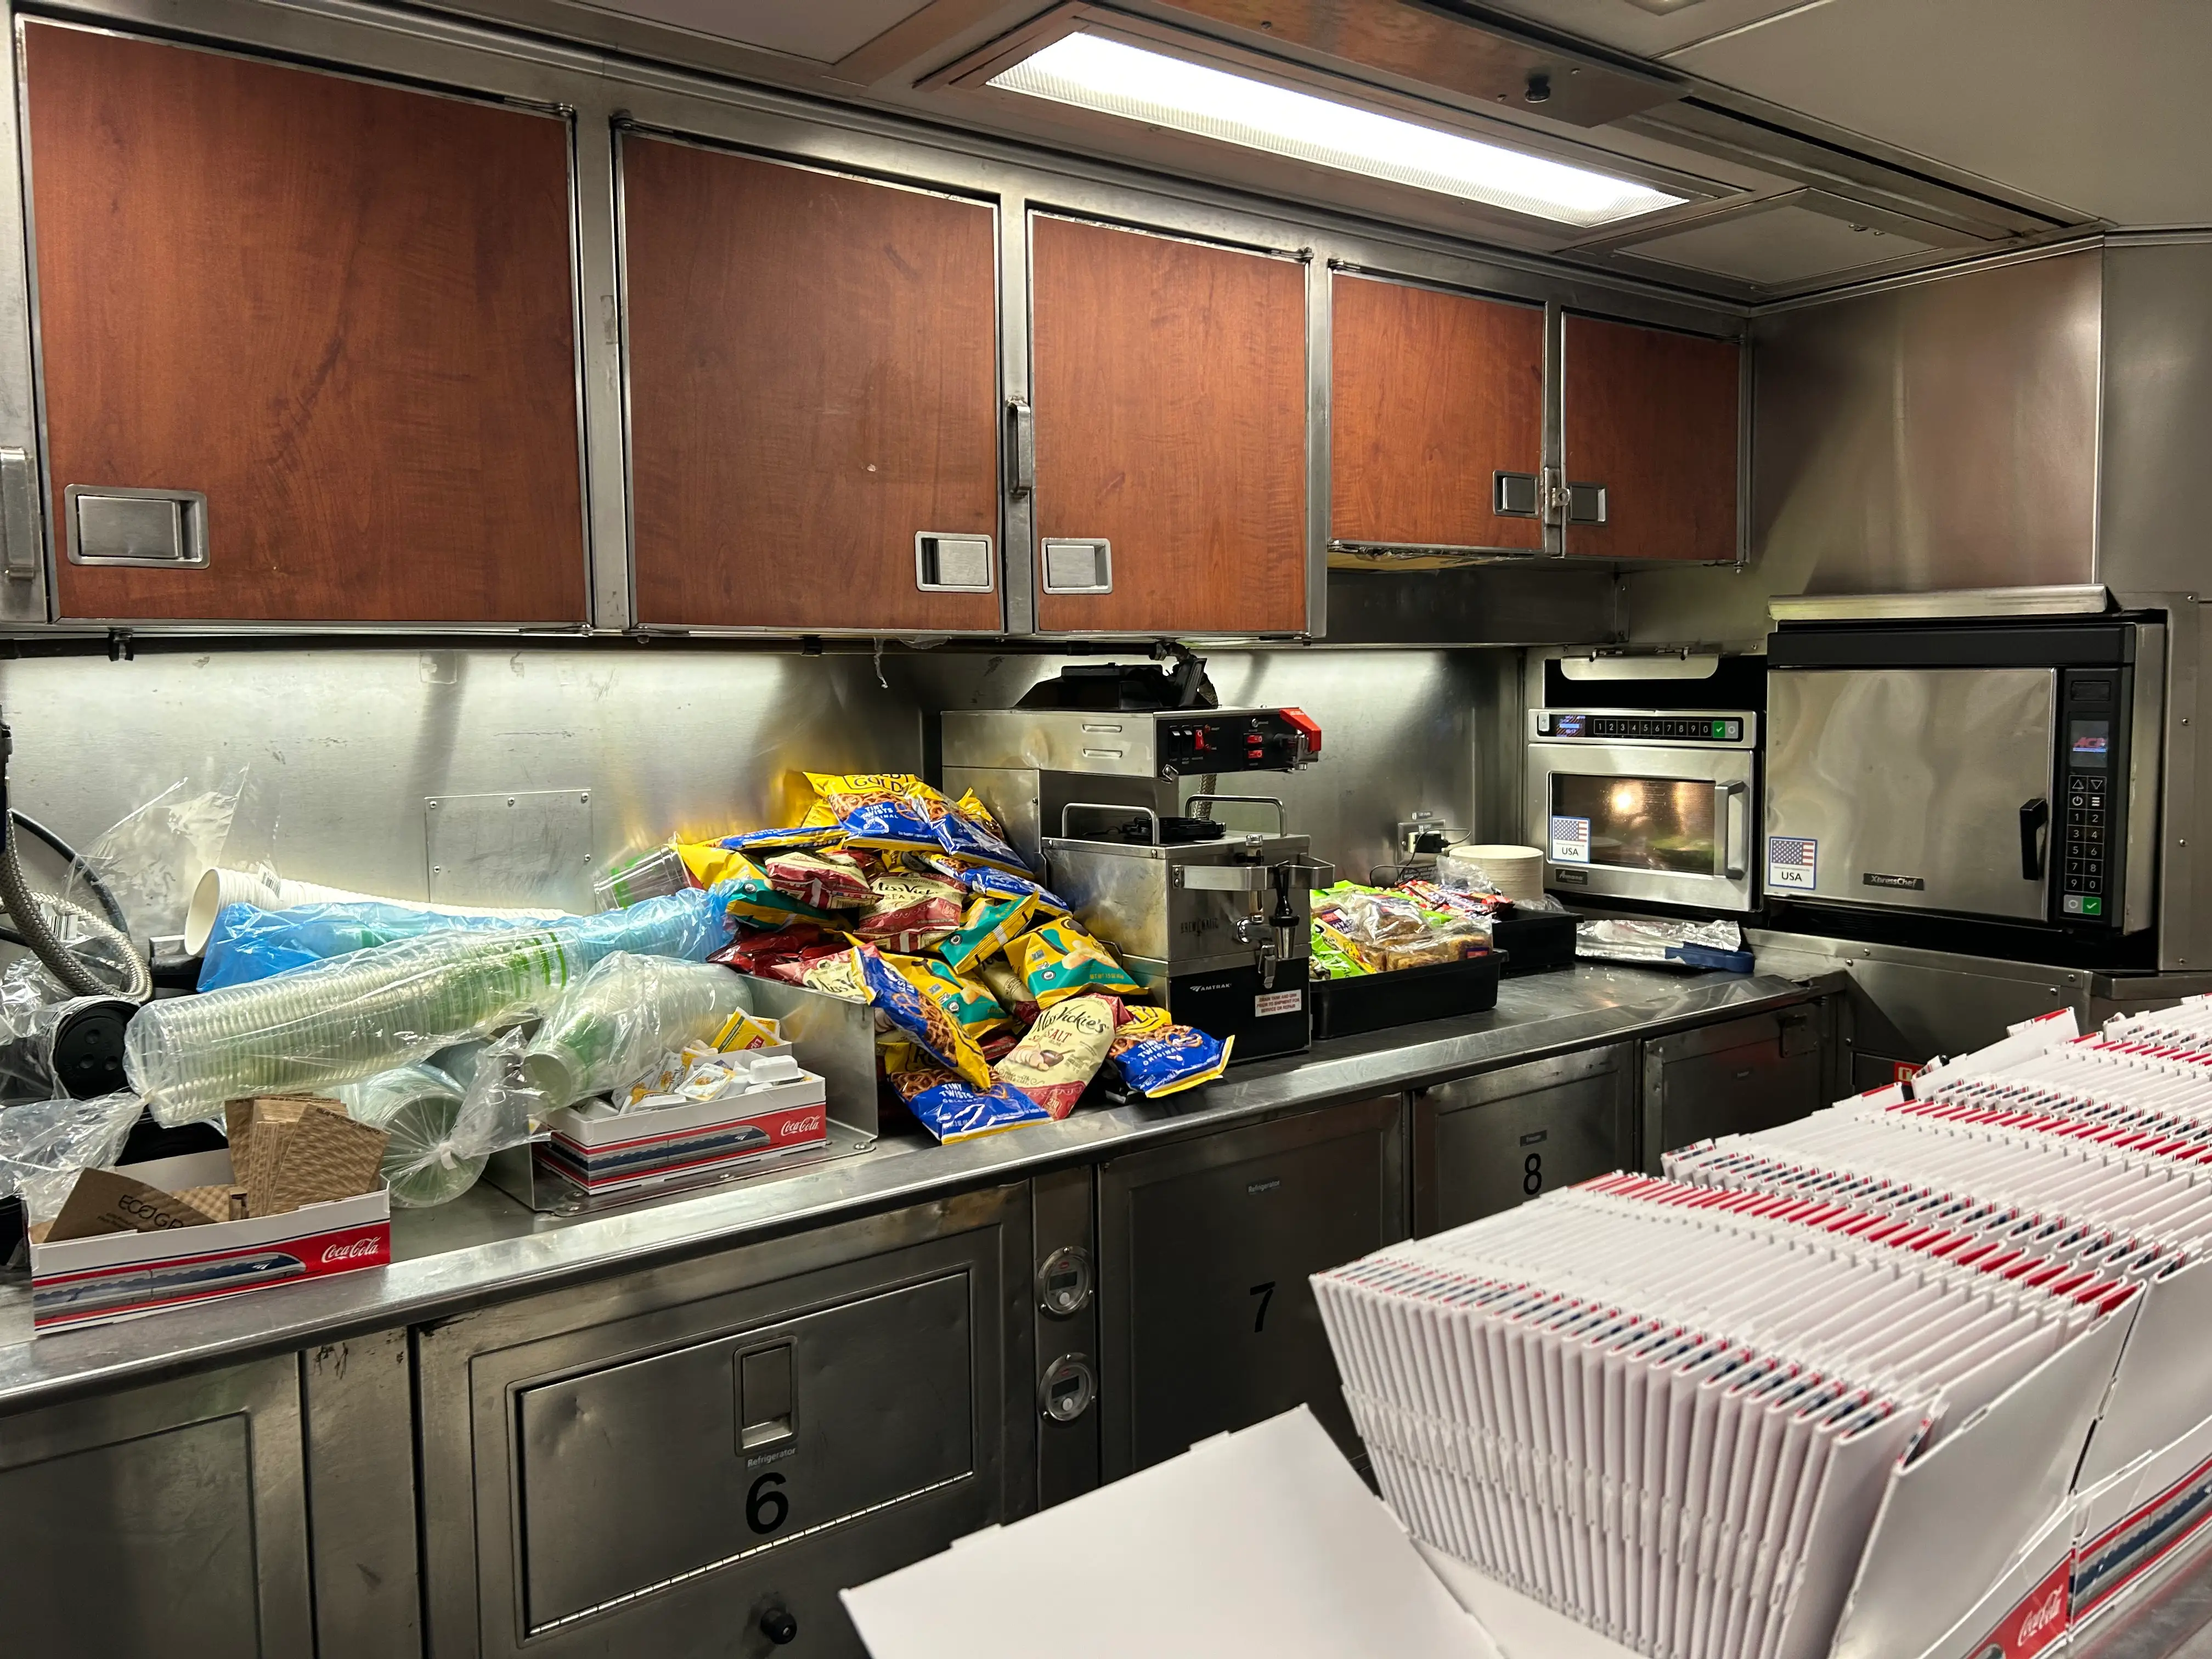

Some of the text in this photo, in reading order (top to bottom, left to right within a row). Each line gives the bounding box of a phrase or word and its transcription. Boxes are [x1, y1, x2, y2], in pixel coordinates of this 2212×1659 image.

[1599, 723, 1602, 731] 1
[1609, 723, 1614, 731] 2
[1620, 723, 1626, 731] 3
[1655, 724, 1660, 732] 6
[1679, 725, 1684, 733] 8
[1703, 725, 1708, 733] 0
[854, 775, 904, 793] GOLD
[865, 804, 884, 812] TINY
[860, 808, 894, 820] TWISTS
[2075, 813, 2098, 823] 1 2
[2073, 829, 2098, 839] 3 4
[1561, 847, 1579, 856] USA
[2072, 846, 2097, 856] 5 6
[2072, 862, 2097, 872] 7 8
[1781, 871, 1803, 882] USA
[2071, 879, 2096, 889] 9 0
[1200, 983, 1231, 991] AMTRAK
[1032, 1004, 1107, 1035] Miss Vickie's
[1047, 1028, 1073, 1043] SALT
[941, 1082, 962, 1092] TINY
[939, 1090, 974, 1099] TWISTS
[1047, 1097, 1060, 1109] 210
[1523, 1153, 1542, 1195] 8
[1248, 1180, 1280, 1193] Refrigerator
[118, 1194, 184, 1229] ECOGR
[321, 1236, 382, 1263] Coca-Cola
[1250, 1280, 1276, 1333] 7
[747, 1447, 797, 1468] Refrigerator
[746, 1472, 789, 1534] 6
